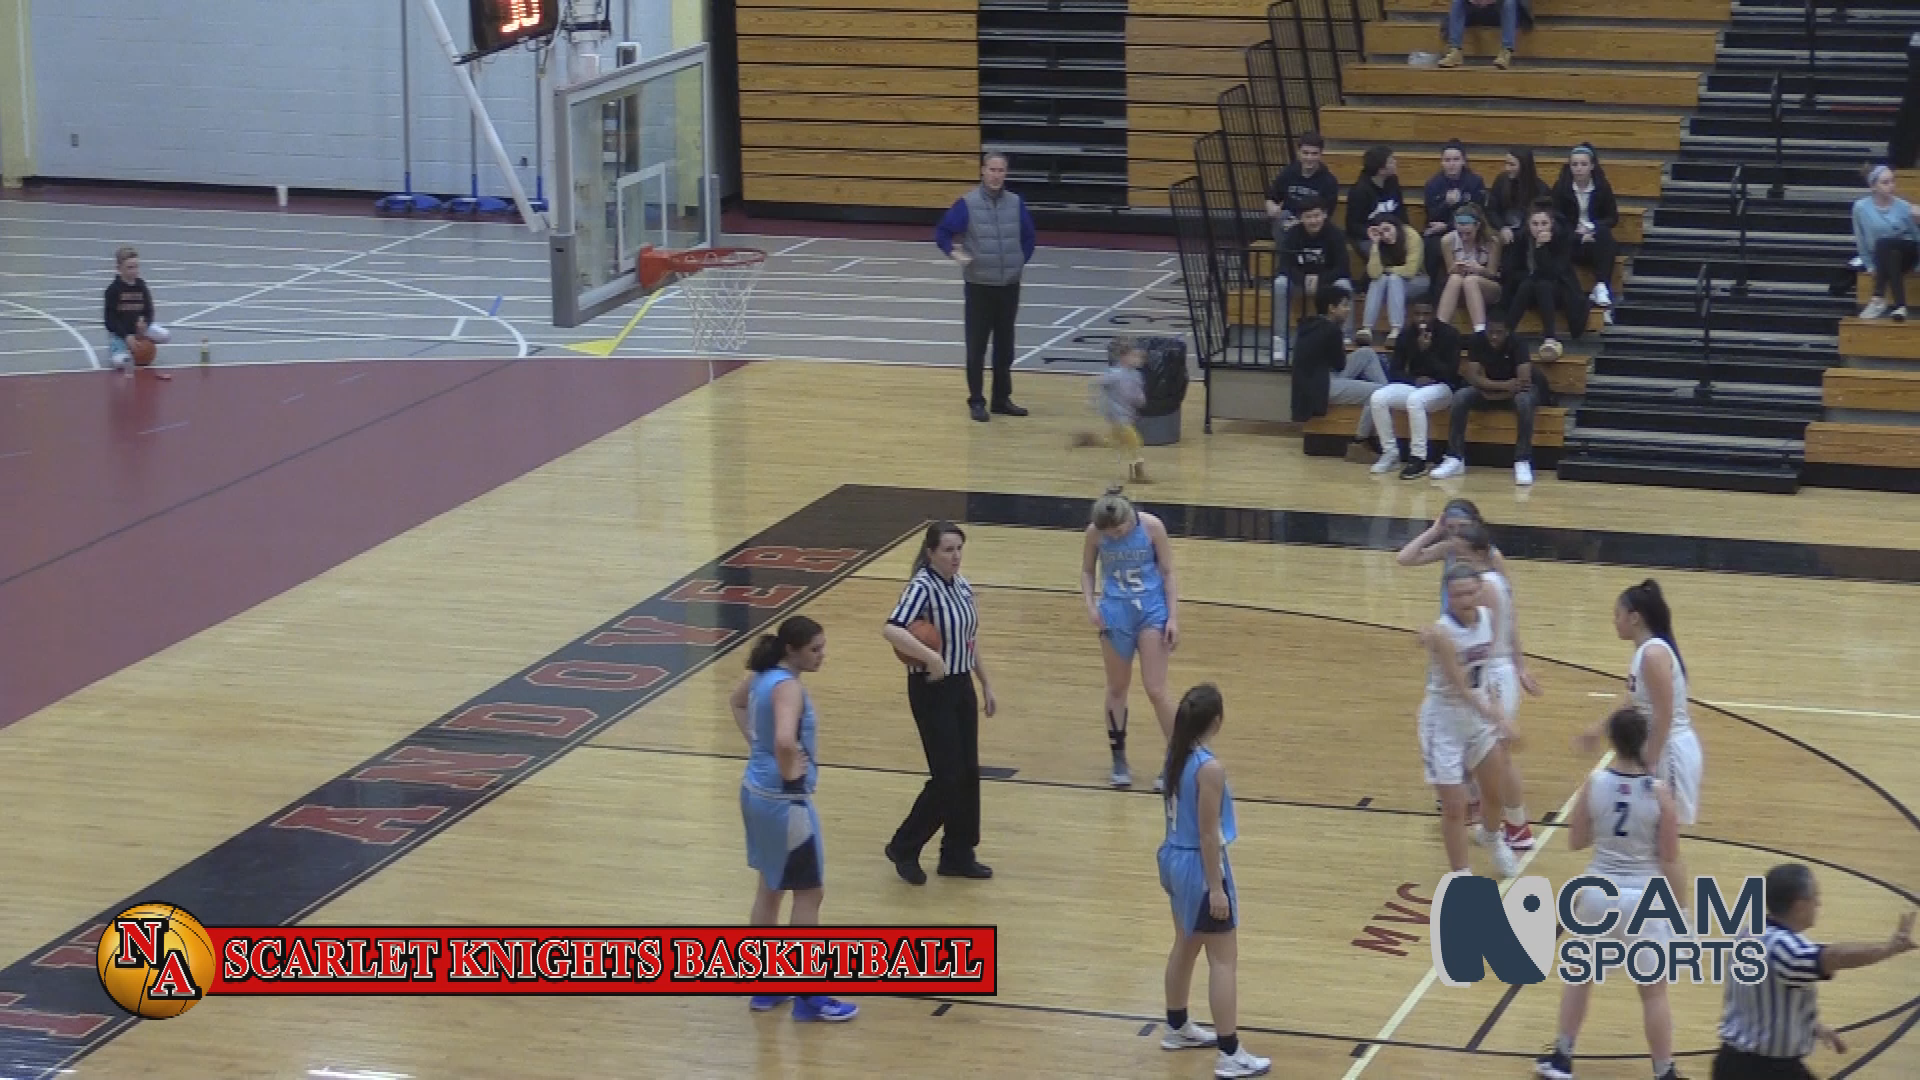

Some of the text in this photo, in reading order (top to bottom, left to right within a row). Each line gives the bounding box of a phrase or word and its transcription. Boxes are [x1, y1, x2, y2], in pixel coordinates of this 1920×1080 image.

[1113, 567, 1146, 593] 15
[270, 545, 868, 846] ANDOVER
[1613, 801, 1631, 837] 2
